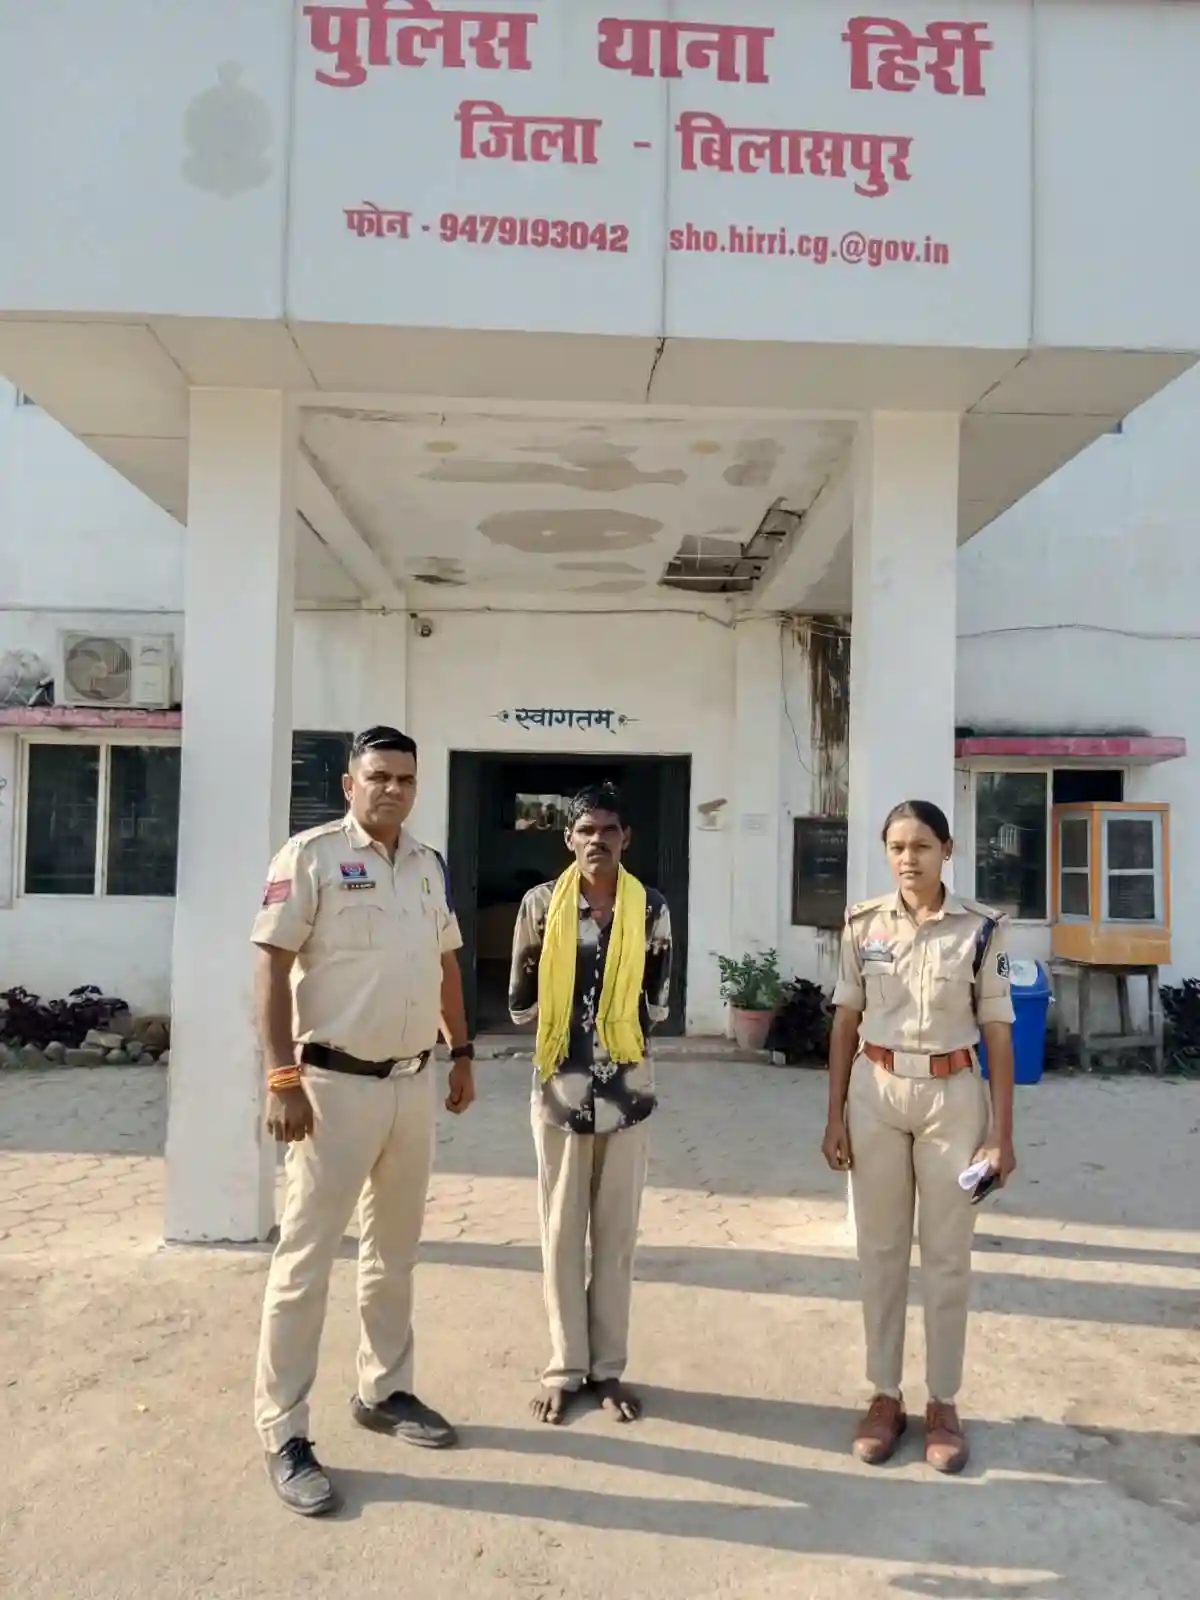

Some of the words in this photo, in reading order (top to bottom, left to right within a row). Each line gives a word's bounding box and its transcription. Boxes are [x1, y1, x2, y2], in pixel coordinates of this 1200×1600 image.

[303, 0, 538, 88] पुलिस
[597, 17, 776, 84] थाना
[841, 16, 993, 97] हिर्री
[454, 100, 602, 164] जिला
[675, 111, 913, 198] बिलासपुर
[343, 200, 412, 239] फोन
[439, 213, 629, 252] 9479193042
[669, 222, 950, 267] sho.hirri.cg.@gov.in
